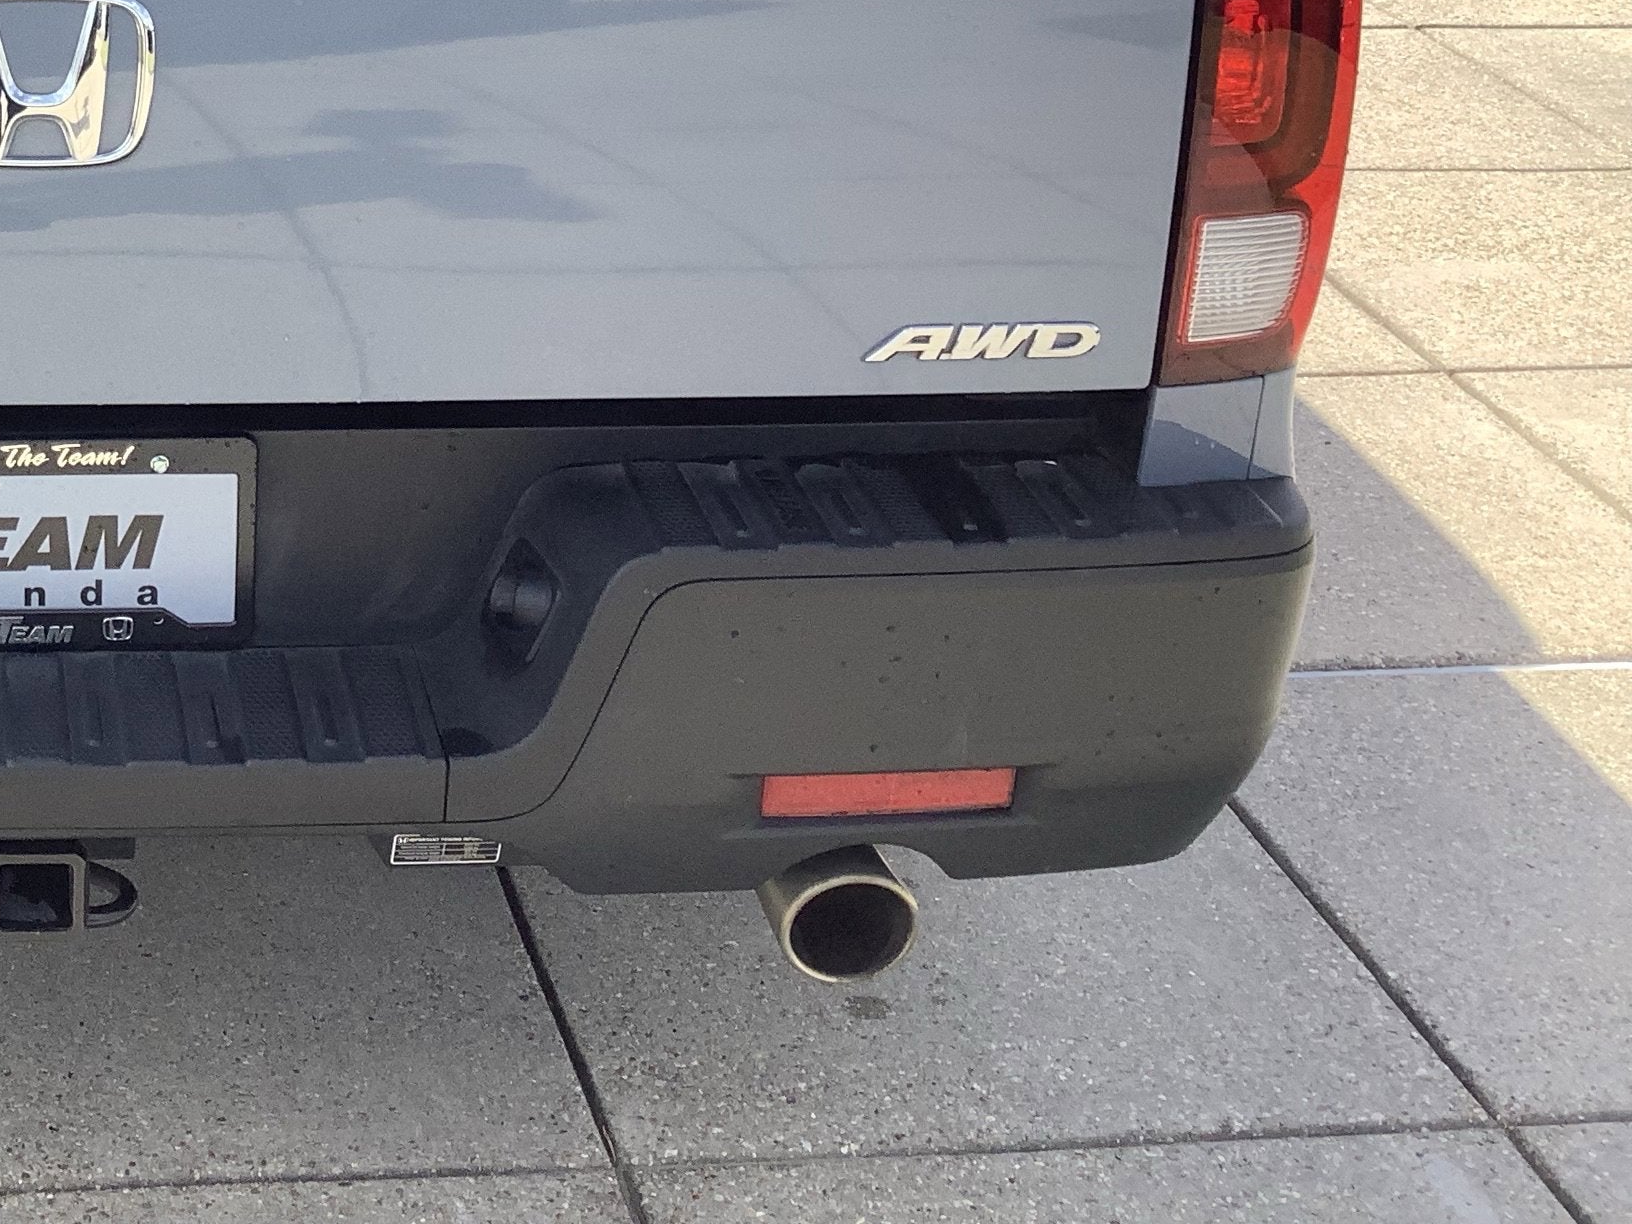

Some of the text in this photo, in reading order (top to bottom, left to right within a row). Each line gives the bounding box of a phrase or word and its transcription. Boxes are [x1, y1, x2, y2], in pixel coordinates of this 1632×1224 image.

[862, 322, 1101, 362] AWD
[0, 444, 49, 468] The
[51, 443, 135, 468] Team!
